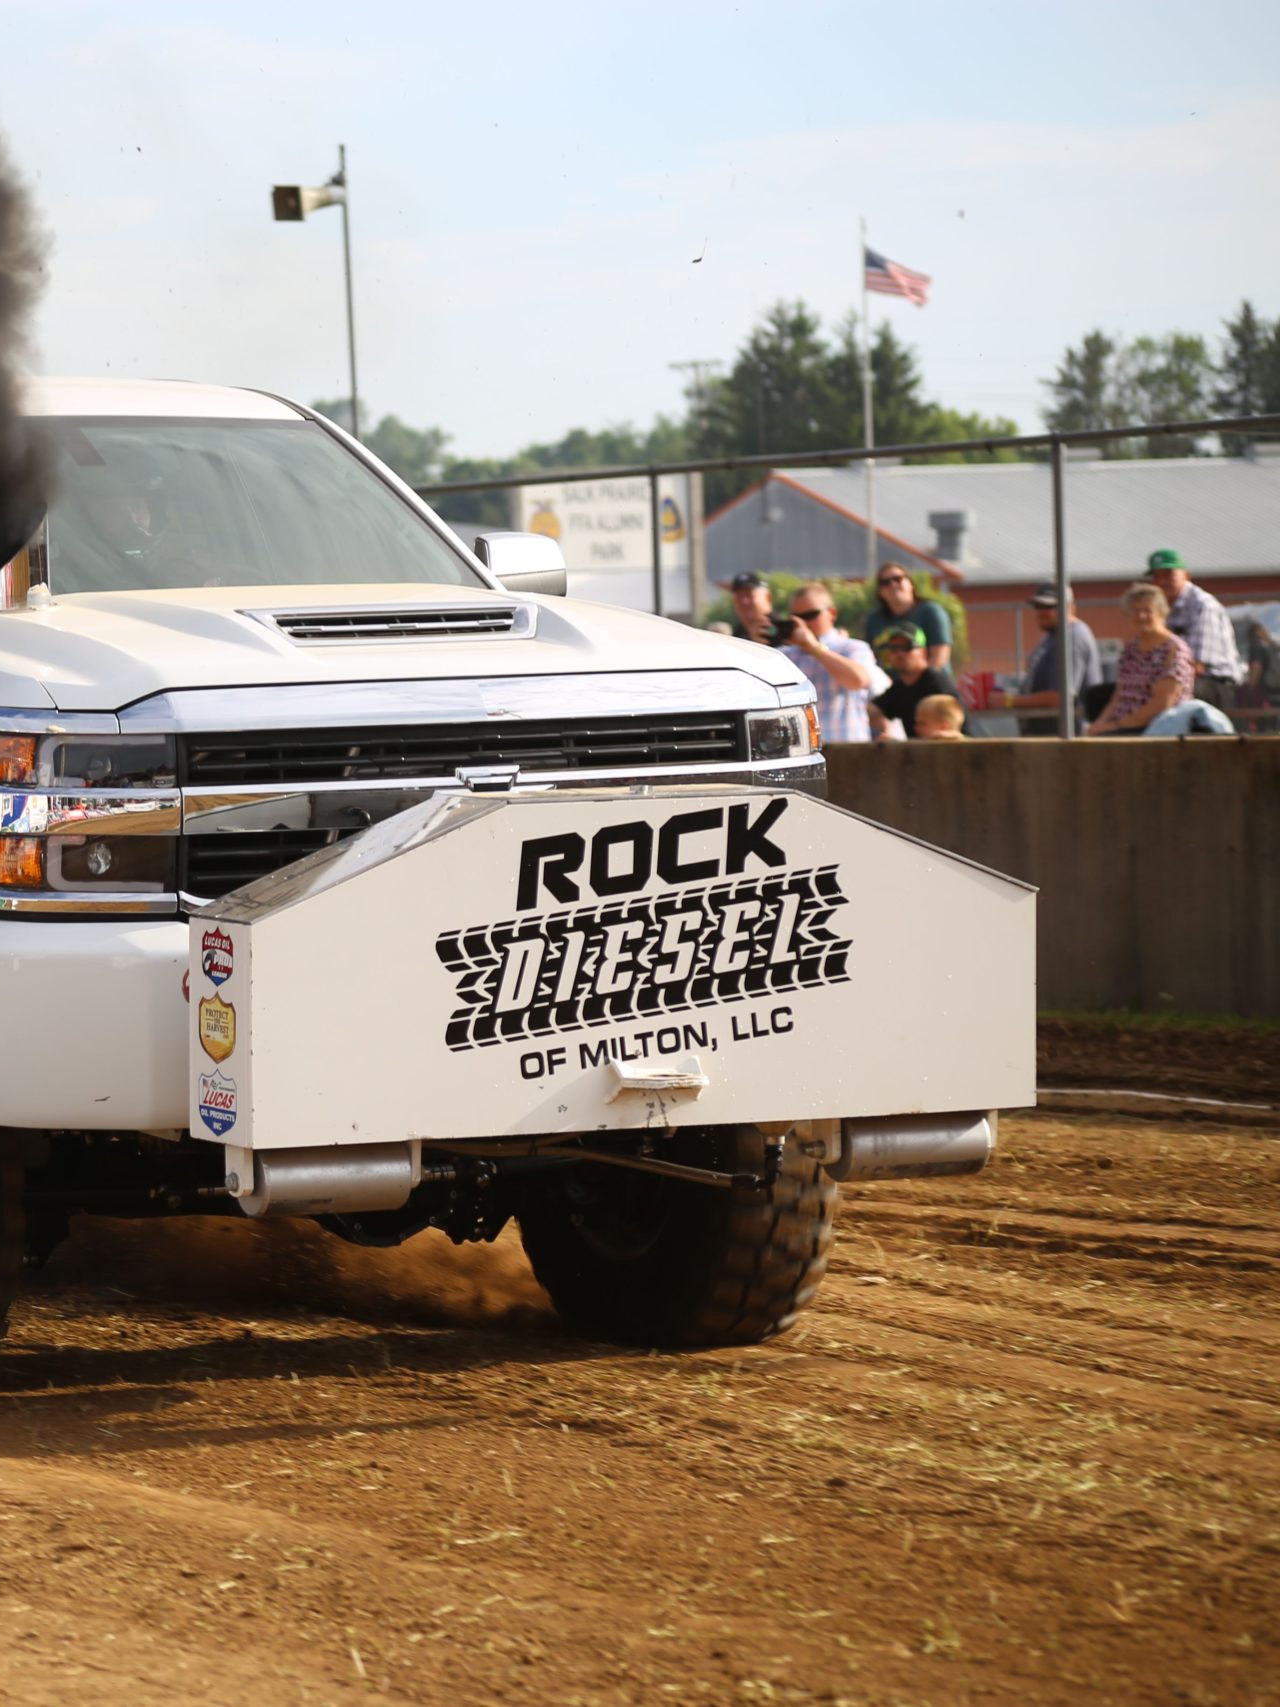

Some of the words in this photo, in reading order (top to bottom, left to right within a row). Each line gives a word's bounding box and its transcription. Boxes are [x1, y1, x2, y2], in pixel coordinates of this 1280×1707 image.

[516, 797, 788, 911] ROCK
[204, 935, 222, 948] LUCAS
[222, 939, 231, 951] OIL
[495, 894, 802, 1014] DIESEL
[205, 1007, 229, 1020] PROTECT
[206, 1021, 229, 1034] HARVEST
[519, 1047, 567, 1081] OF
[579, 1021, 718, 1069] MILTON,
[731, 1006, 794, 1041] LLC
[203, 1089, 234, 1109] LUCAS
[200, 1107, 209, 1117] OIL
[209, 1110, 235, 1123] PRODUCTS
[213, 1121, 223, 1131] INC
